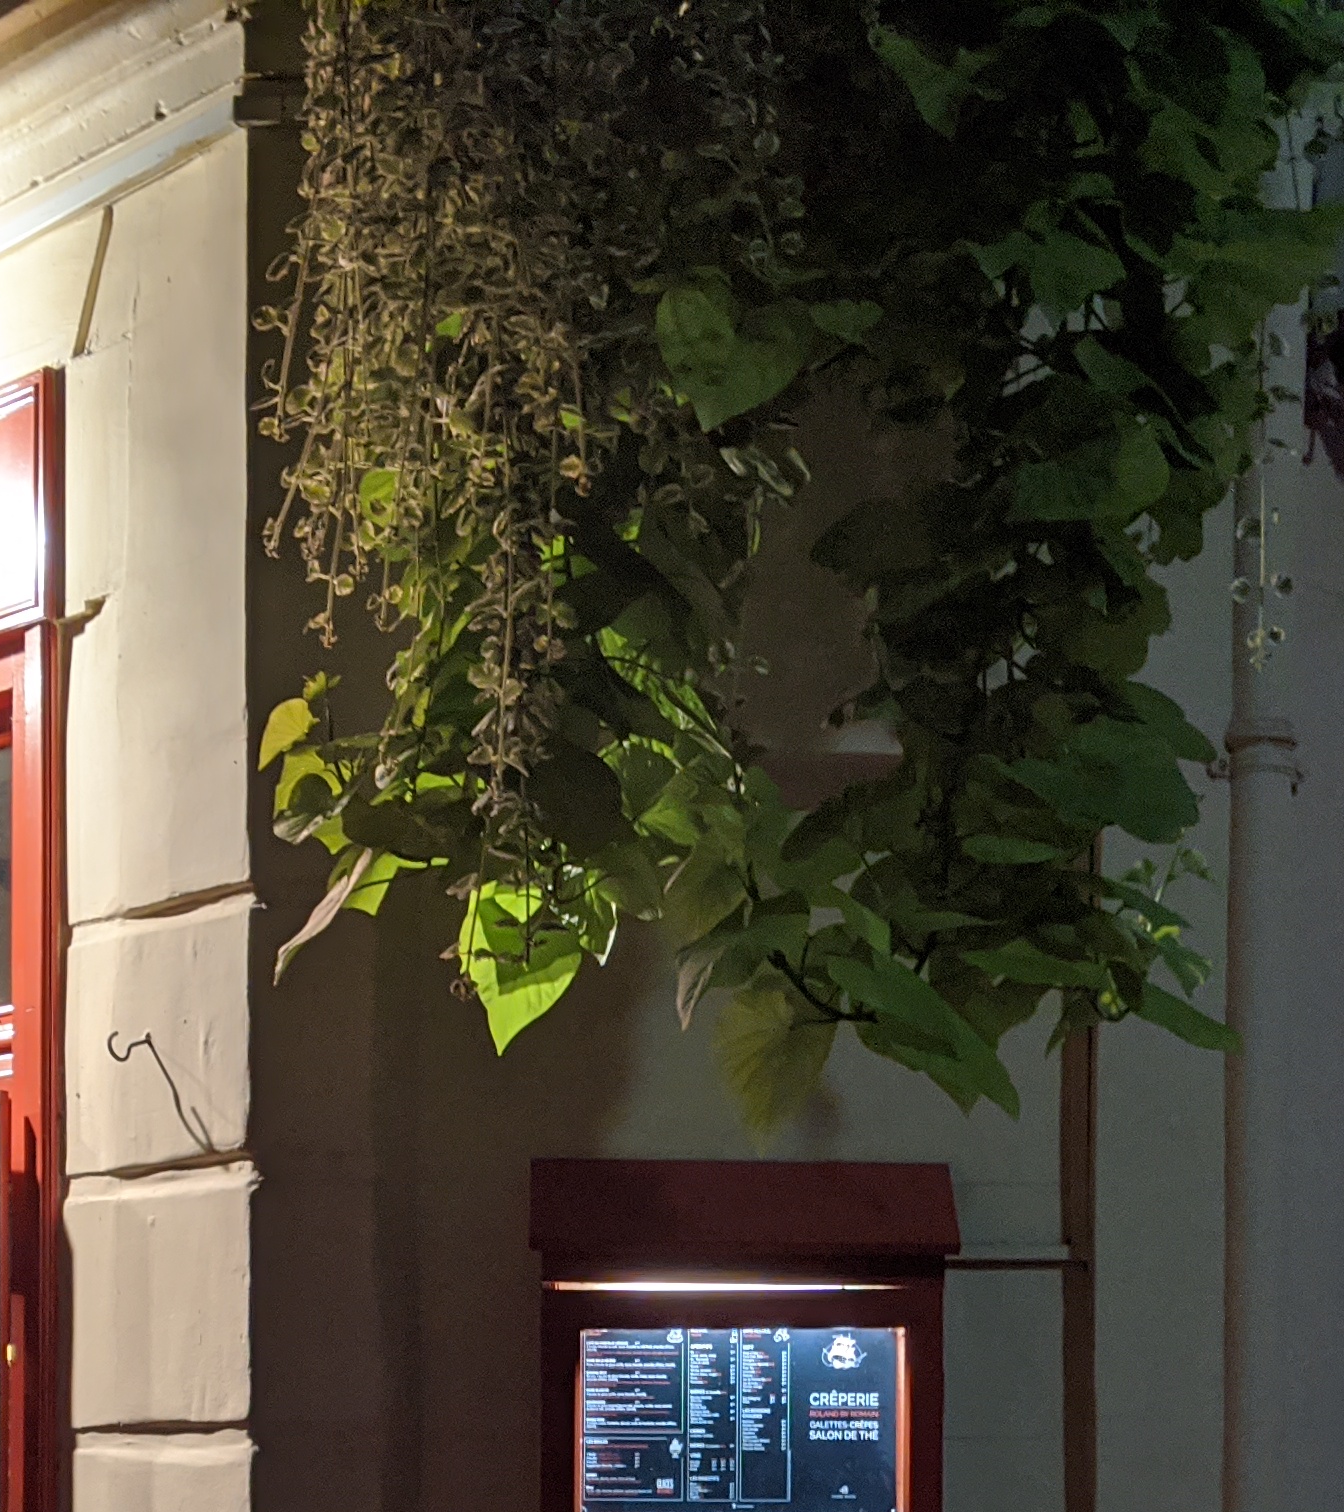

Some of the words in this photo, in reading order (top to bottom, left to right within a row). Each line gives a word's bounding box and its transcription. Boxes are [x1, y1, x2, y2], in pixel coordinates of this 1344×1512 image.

[809, 1389, 879, 1407] CRÊPERIE
[809, 1430, 843, 1441] SALON
[844, 1430, 858, 1441] DE
[859, 1429, 879, 1441] THÉ
